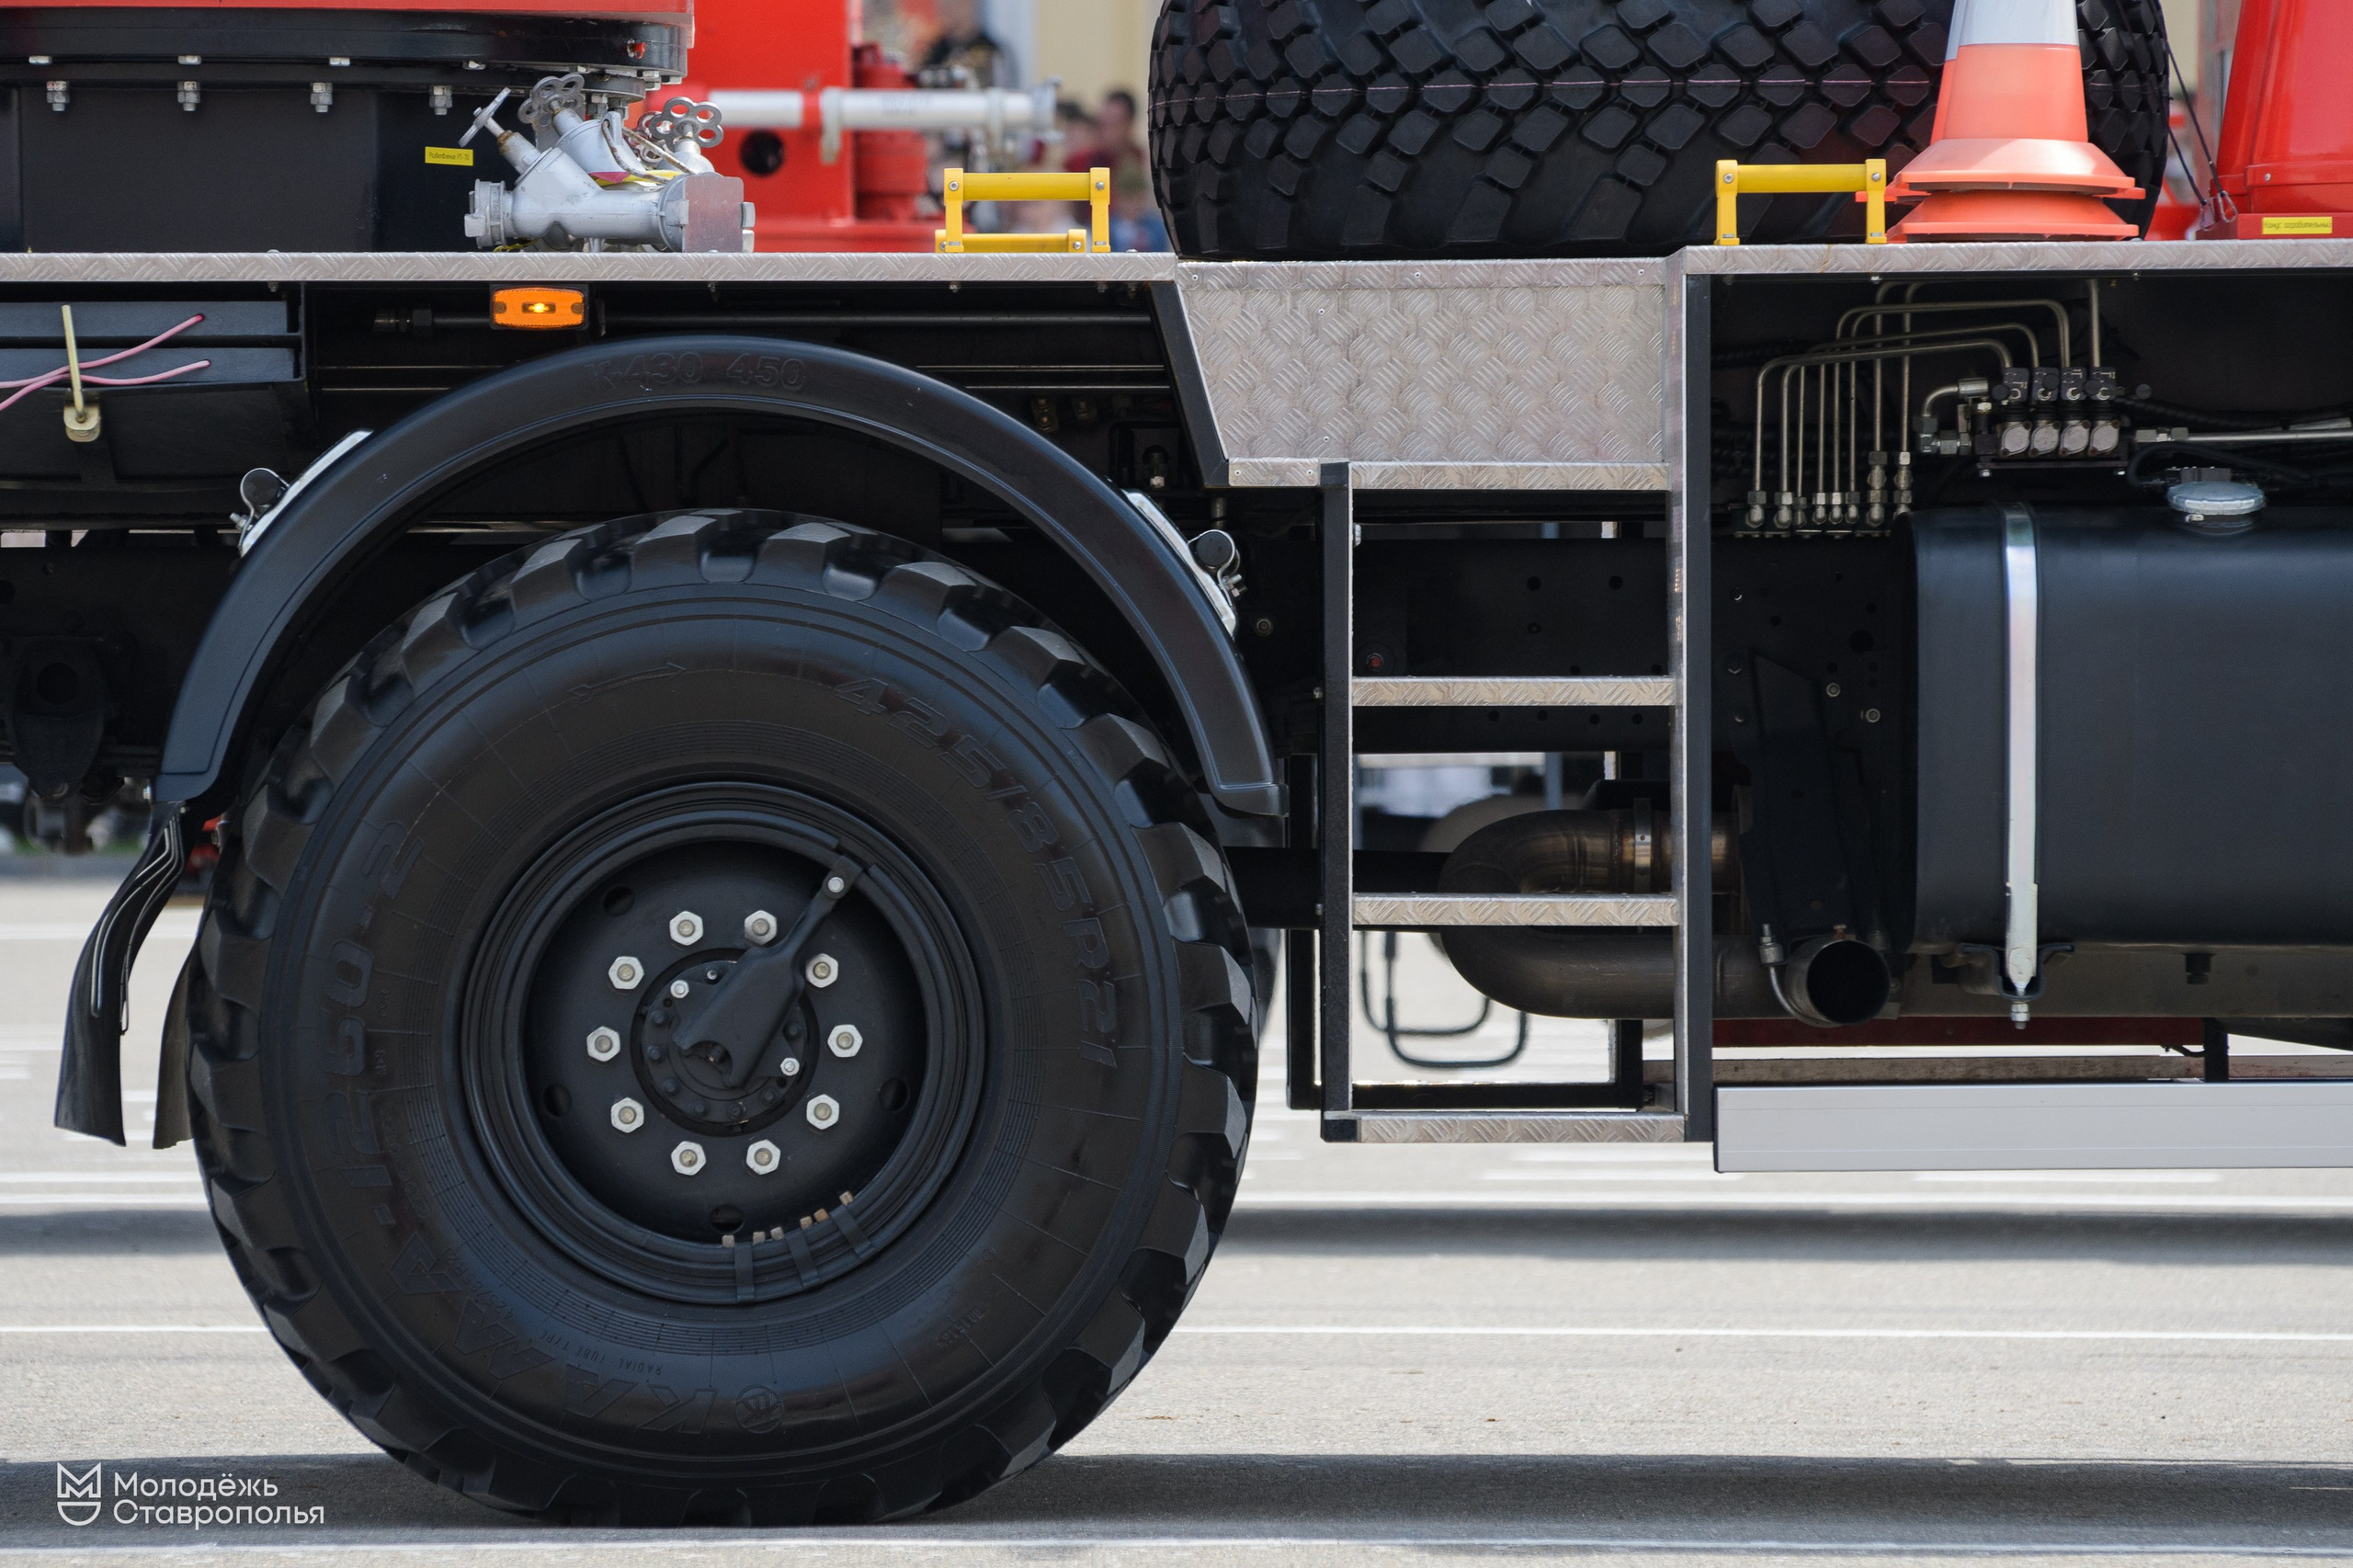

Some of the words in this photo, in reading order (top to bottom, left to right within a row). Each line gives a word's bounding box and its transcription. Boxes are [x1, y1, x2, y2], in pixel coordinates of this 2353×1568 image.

[725, 352, 807, 392] 450
[834, 676, 1117, 1069] 425/85R21
[540, 1329, 571, 1351] TYPE
[574, 1344, 607, 1365] TUBE
[618, 1356, 664, 1377] RADIAL
